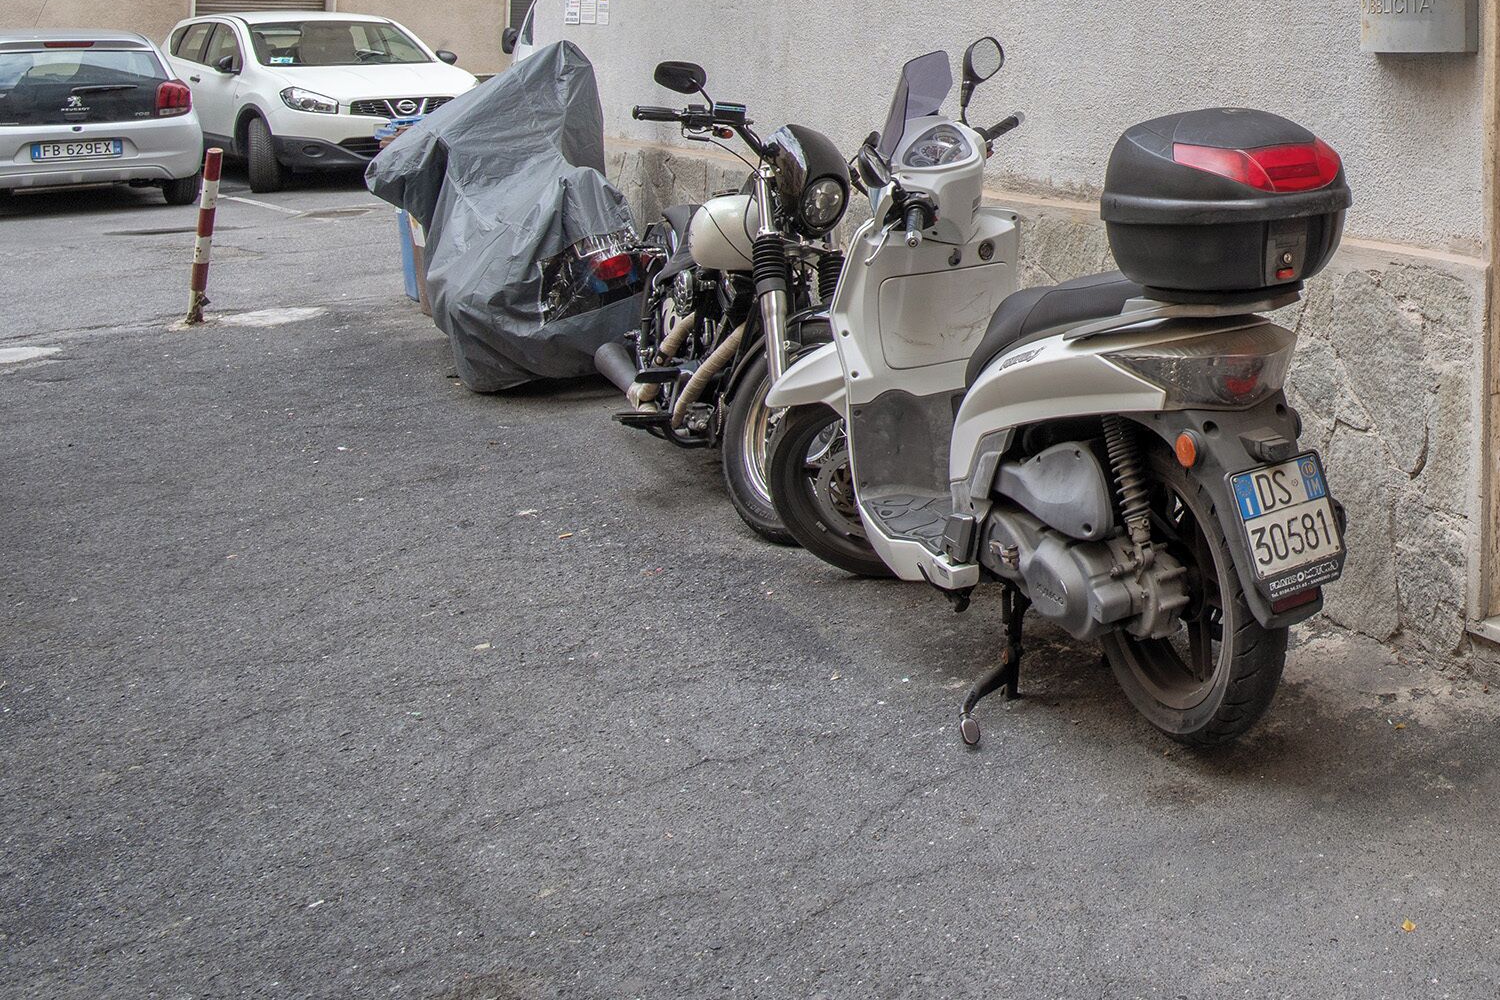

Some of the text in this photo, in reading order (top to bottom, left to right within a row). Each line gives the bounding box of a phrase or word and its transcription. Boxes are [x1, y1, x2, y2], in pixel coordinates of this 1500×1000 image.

[43, 144, 61, 157] FB
[67, 140, 112, 155] 629EX
[1245, 478, 1323, 516] I IM
[1255, 470, 1292, 511] DS
[1251, 508, 1331, 565] 30581
